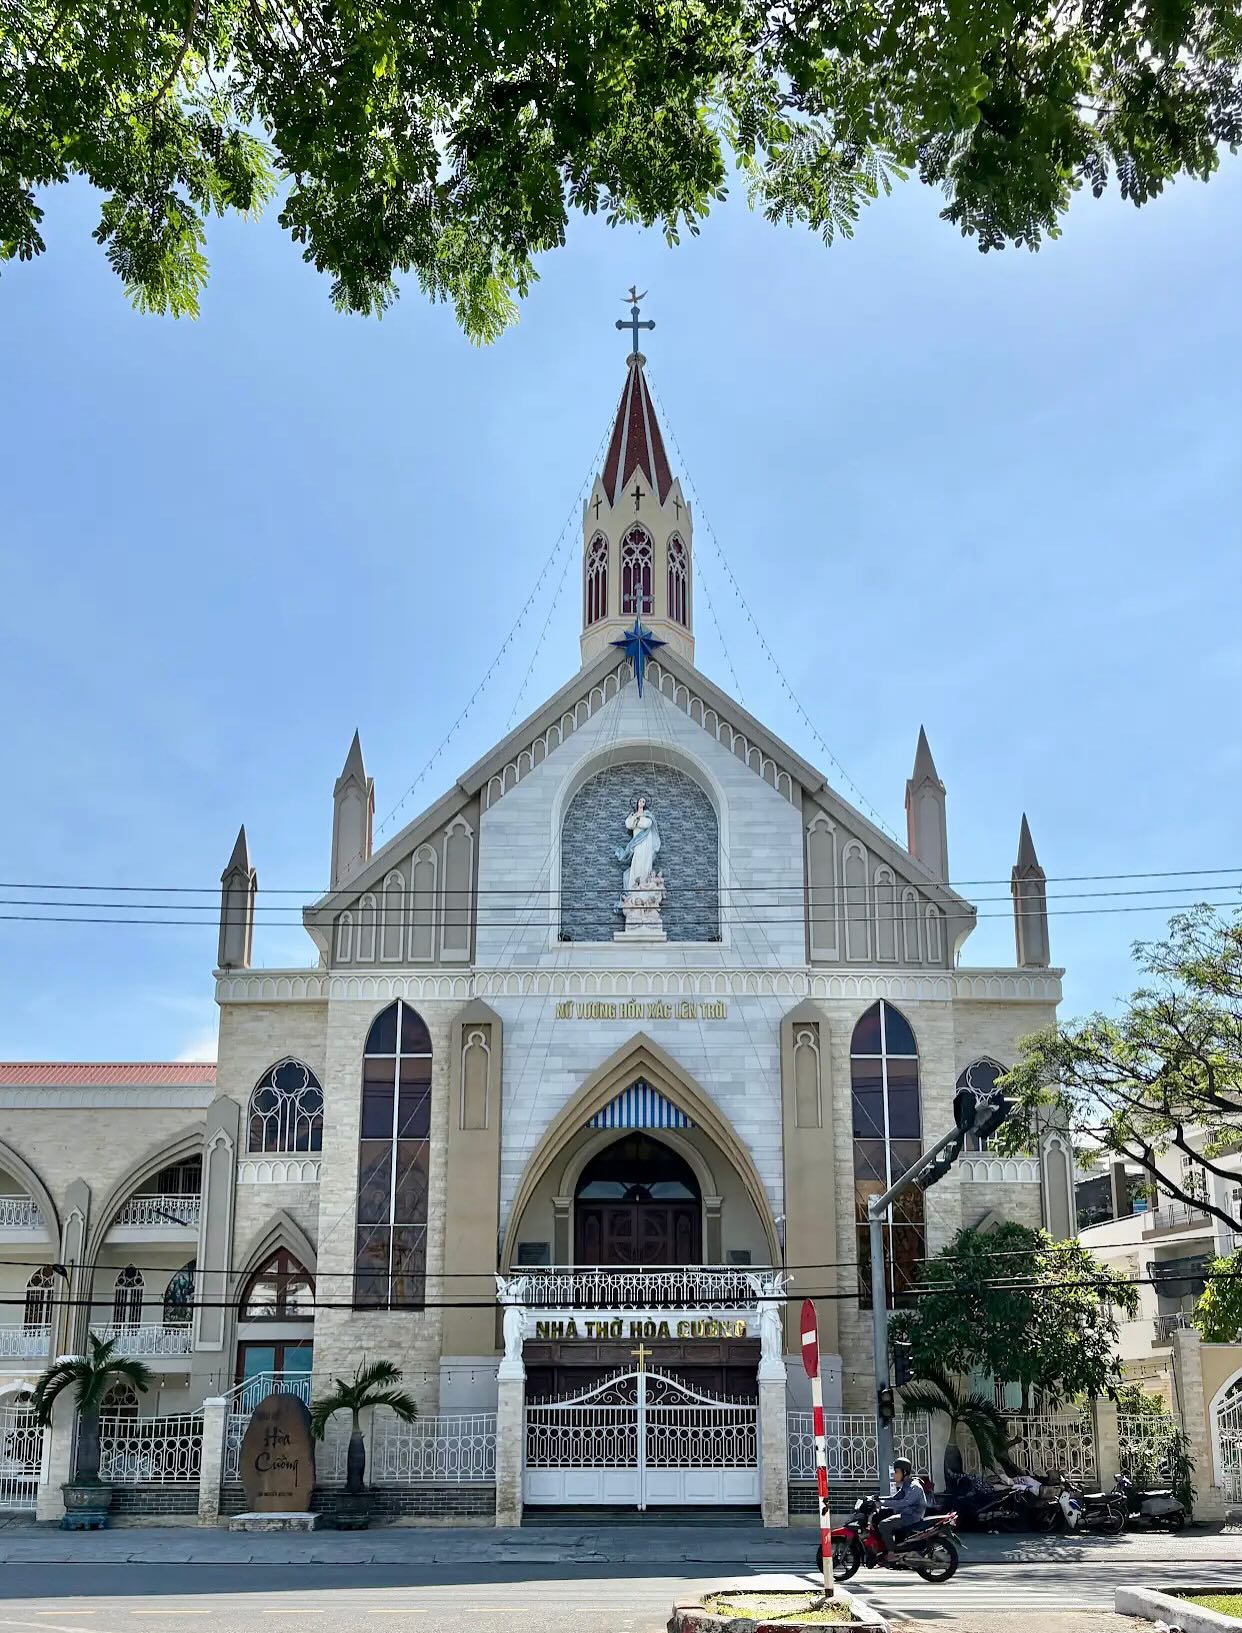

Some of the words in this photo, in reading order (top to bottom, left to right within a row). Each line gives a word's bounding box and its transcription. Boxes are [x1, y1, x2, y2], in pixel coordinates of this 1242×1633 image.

[619, 998, 644, 1019] HỒN
[647, 1000, 672, 1019] XÁC
[675, 1001, 697, 1019] LÊN
[536, 1317, 578, 1338] NHÀ
[584, 1316, 624, 1338] THỜ
[629, 1317, 671, 1338] HÒA
[677, 1316, 747, 1339] CƯỜNG
